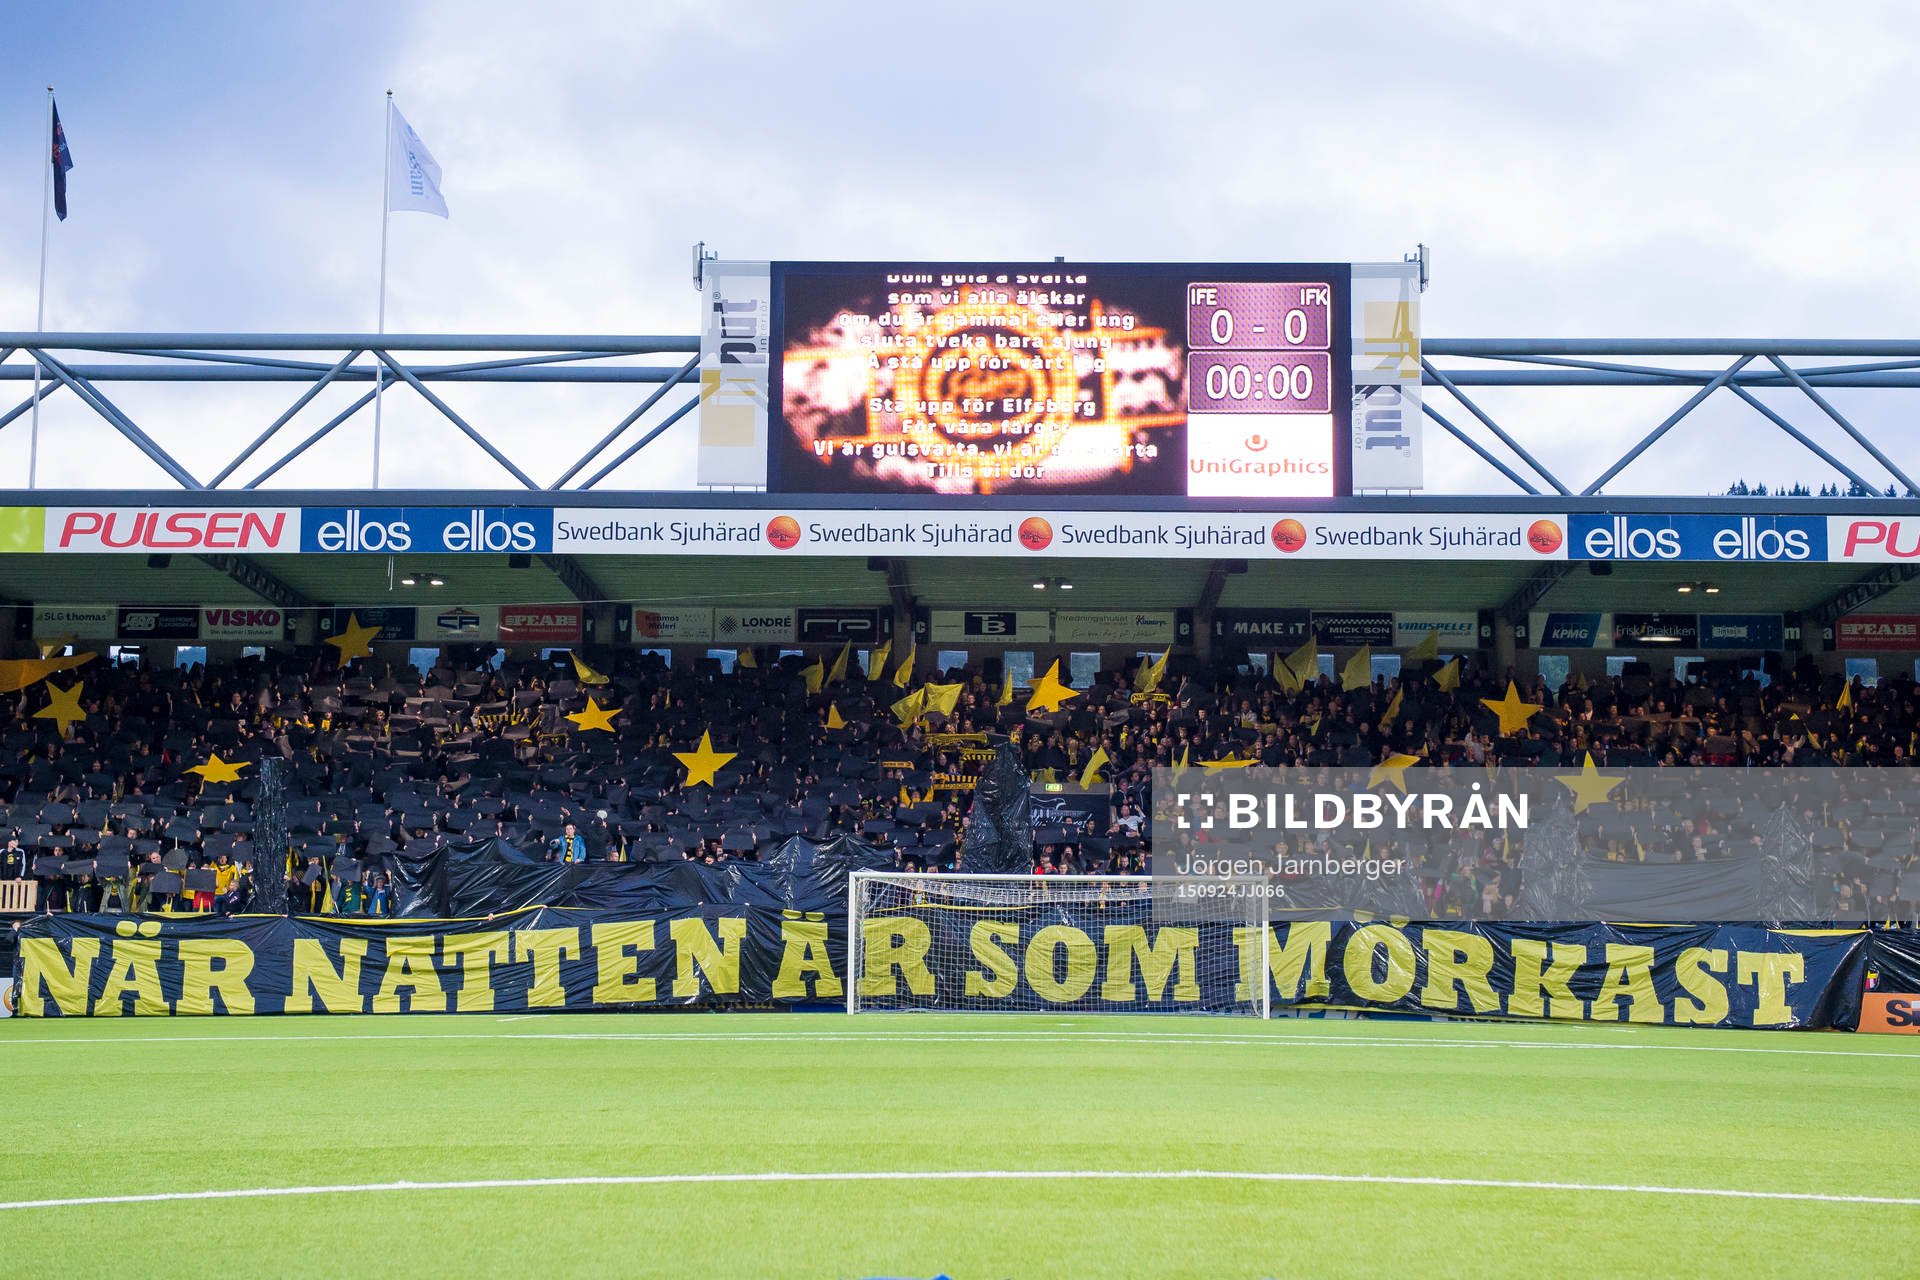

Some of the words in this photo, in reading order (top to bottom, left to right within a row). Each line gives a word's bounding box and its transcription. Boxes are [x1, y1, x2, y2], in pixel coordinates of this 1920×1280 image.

[888, 291, 932, 305] som
[940, 290, 960, 305] vi
[967, 290, 1009, 305] alla
[1016, 289, 1086, 305] älskar
[1190, 288, 1218, 306] IFE
[1300, 288, 1328, 306] IFK
[839, 313, 870, 326] om
[878, 312, 904, 327] du
[944, 312, 1028, 331] gammal
[1036, 312, 1087, 327] eller
[1095, 314, 1135, 331] ung
[1210, 308, 1234, 345] 0
[1284, 308, 1308, 345] 0
[860, 334, 917, 348] sluta
[925, 333, 987, 348] tveka
[995, 333, 1044, 348] bara
[1053, 332, 1112, 351] sjung
[931, 356, 971, 372] upp
[979, 354, 1011, 370] för
[1019, 354, 1065, 370] vårt
[1205, 363, 1314, 401] 00:00
[914, 400, 954, 416] upp
[961, 396, 995, 413] för
[1002, 398, 1096, 417] Elfsborg
[945, 418, 993, 434] våra
[813, 439, 834, 456] Vi
[993, 440, 1012, 457] vi
[1190, 458, 1329, 477] UniGraphics
[59, 511, 286, 549] PULSEN
[317, 509, 412, 551] ellos
[442, 509, 537, 551] ellos
[557, 521, 664, 541] Swedbank
[670, 522, 760, 546] Sjuhärad
[809, 522, 916, 543] Swedbank
[922, 523, 1012, 548] Sjuhärad
[1061, 524, 1168, 544] Swedbank
[1175, 525, 1265, 549] Sjuhärad
[1315, 526, 1423, 546] Swedbank
[1430, 527, 1521, 551] Sjuhärad
[1585, 516, 1682, 560] ellos
[1712, 516, 1811, 560] ellos
[205, 608, 281, 627] VISKO
[514, 615, 569, 626] PEAB
[741, 615, 792, 628] LONDRÉ
[320, 617, 331, 630] e
[1179, 622, 1190, 635] e
[1783, 626, 1801, 639] m
[1233, 622, 1284, 635] MAKE
[1552, 628, 1590, 640] KPMG
[1616, 625, 1640, 637] Frisk
[1646, 625, 1696, 637] Praktiken
[1850, 623, 1909, 635] PEAB
[19, 920, 255, 1017] NÄR
[284, 917, 748, 1014] NATTEN
[771, 909, 936, 999] ÄR
[963, 919, 1201, 1003] SOM
[1233, 909, 1805, 1026] MÖRKAST
